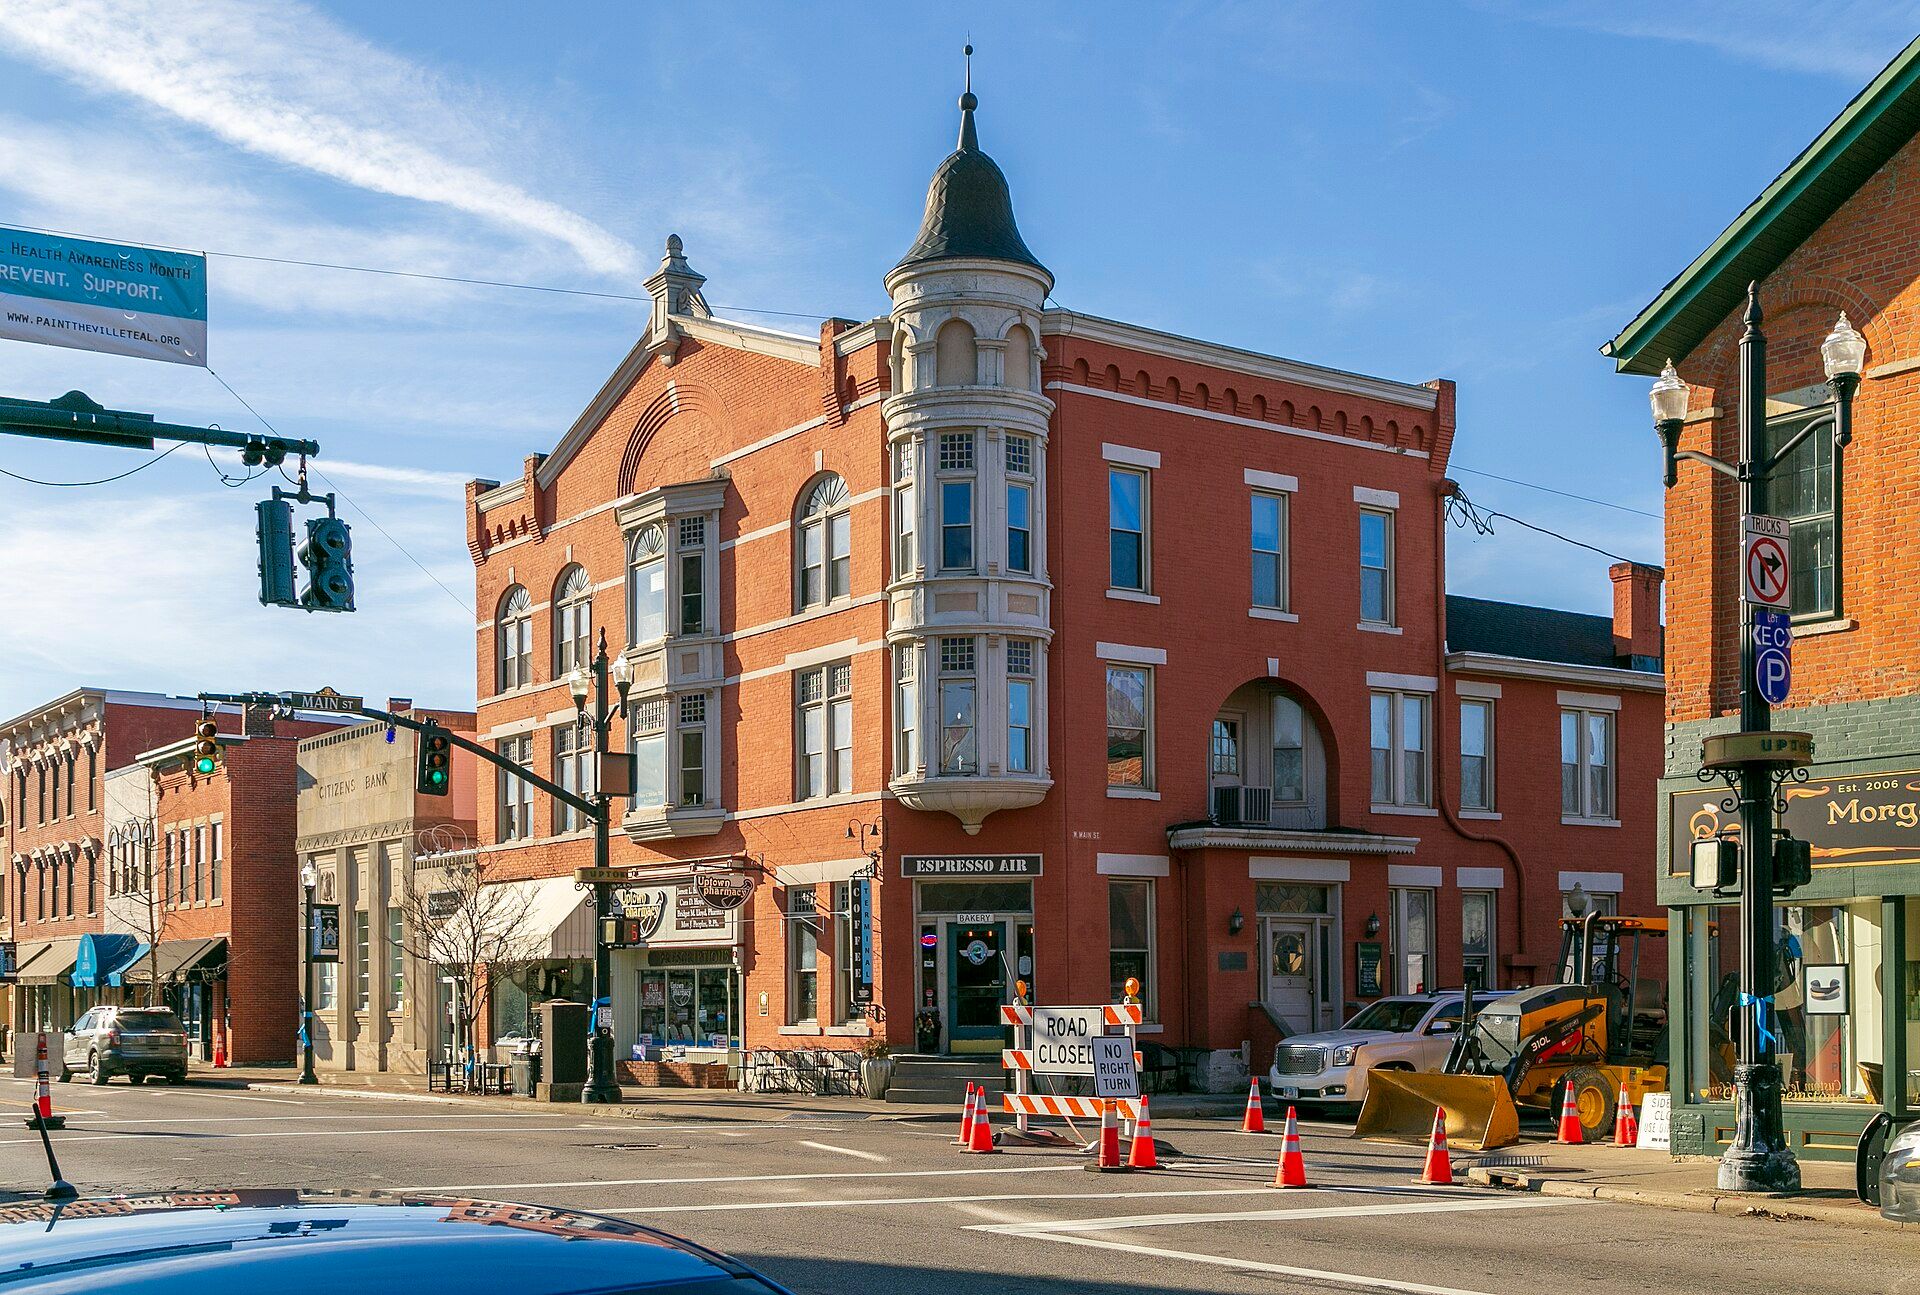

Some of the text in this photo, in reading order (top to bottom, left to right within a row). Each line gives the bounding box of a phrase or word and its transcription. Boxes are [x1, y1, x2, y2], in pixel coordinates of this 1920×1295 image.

[68, 251, 144, 273] AWARENESS
[150, 262, 191, 280] MONTH
[83, 273, 163, 301] SUPPORT.
[1751, 516, 1782, 534] TRUCKS
[1767, 615, 1778, 623] LOT
[1761, 625, 1785, 648] EC
[1766, 658, 1786, 696] P
[302, 695, 353, 710] MAIN ST
[319, 771, 388, 799] CITIZENS BANK
[1838, 780, 1899, 793] Est. 2006
[1826, 798, 1920, 828] Morg
[916, 859, 1028, 873] ESPRESSO AIR
[698, 876, 731, 888] Uptown
[703, 887, 747, 898] pharmacy
[959, 914, 991, 922] BAKERY
[853, 887, 861, 978] COFFEE
[648, 983, 659, 991] FLU
[645, 991, 662, 1000] SHOTS
[1047, 1017, 1088, 1037] ROAD
[1104, 1044, 1122, 1059] NO
[1530, 1036, 1551, 1052] 310L
[1099, 1062, 1130, 1075] RIGHT
[1103, 1078, 1131, 1090] TURN
